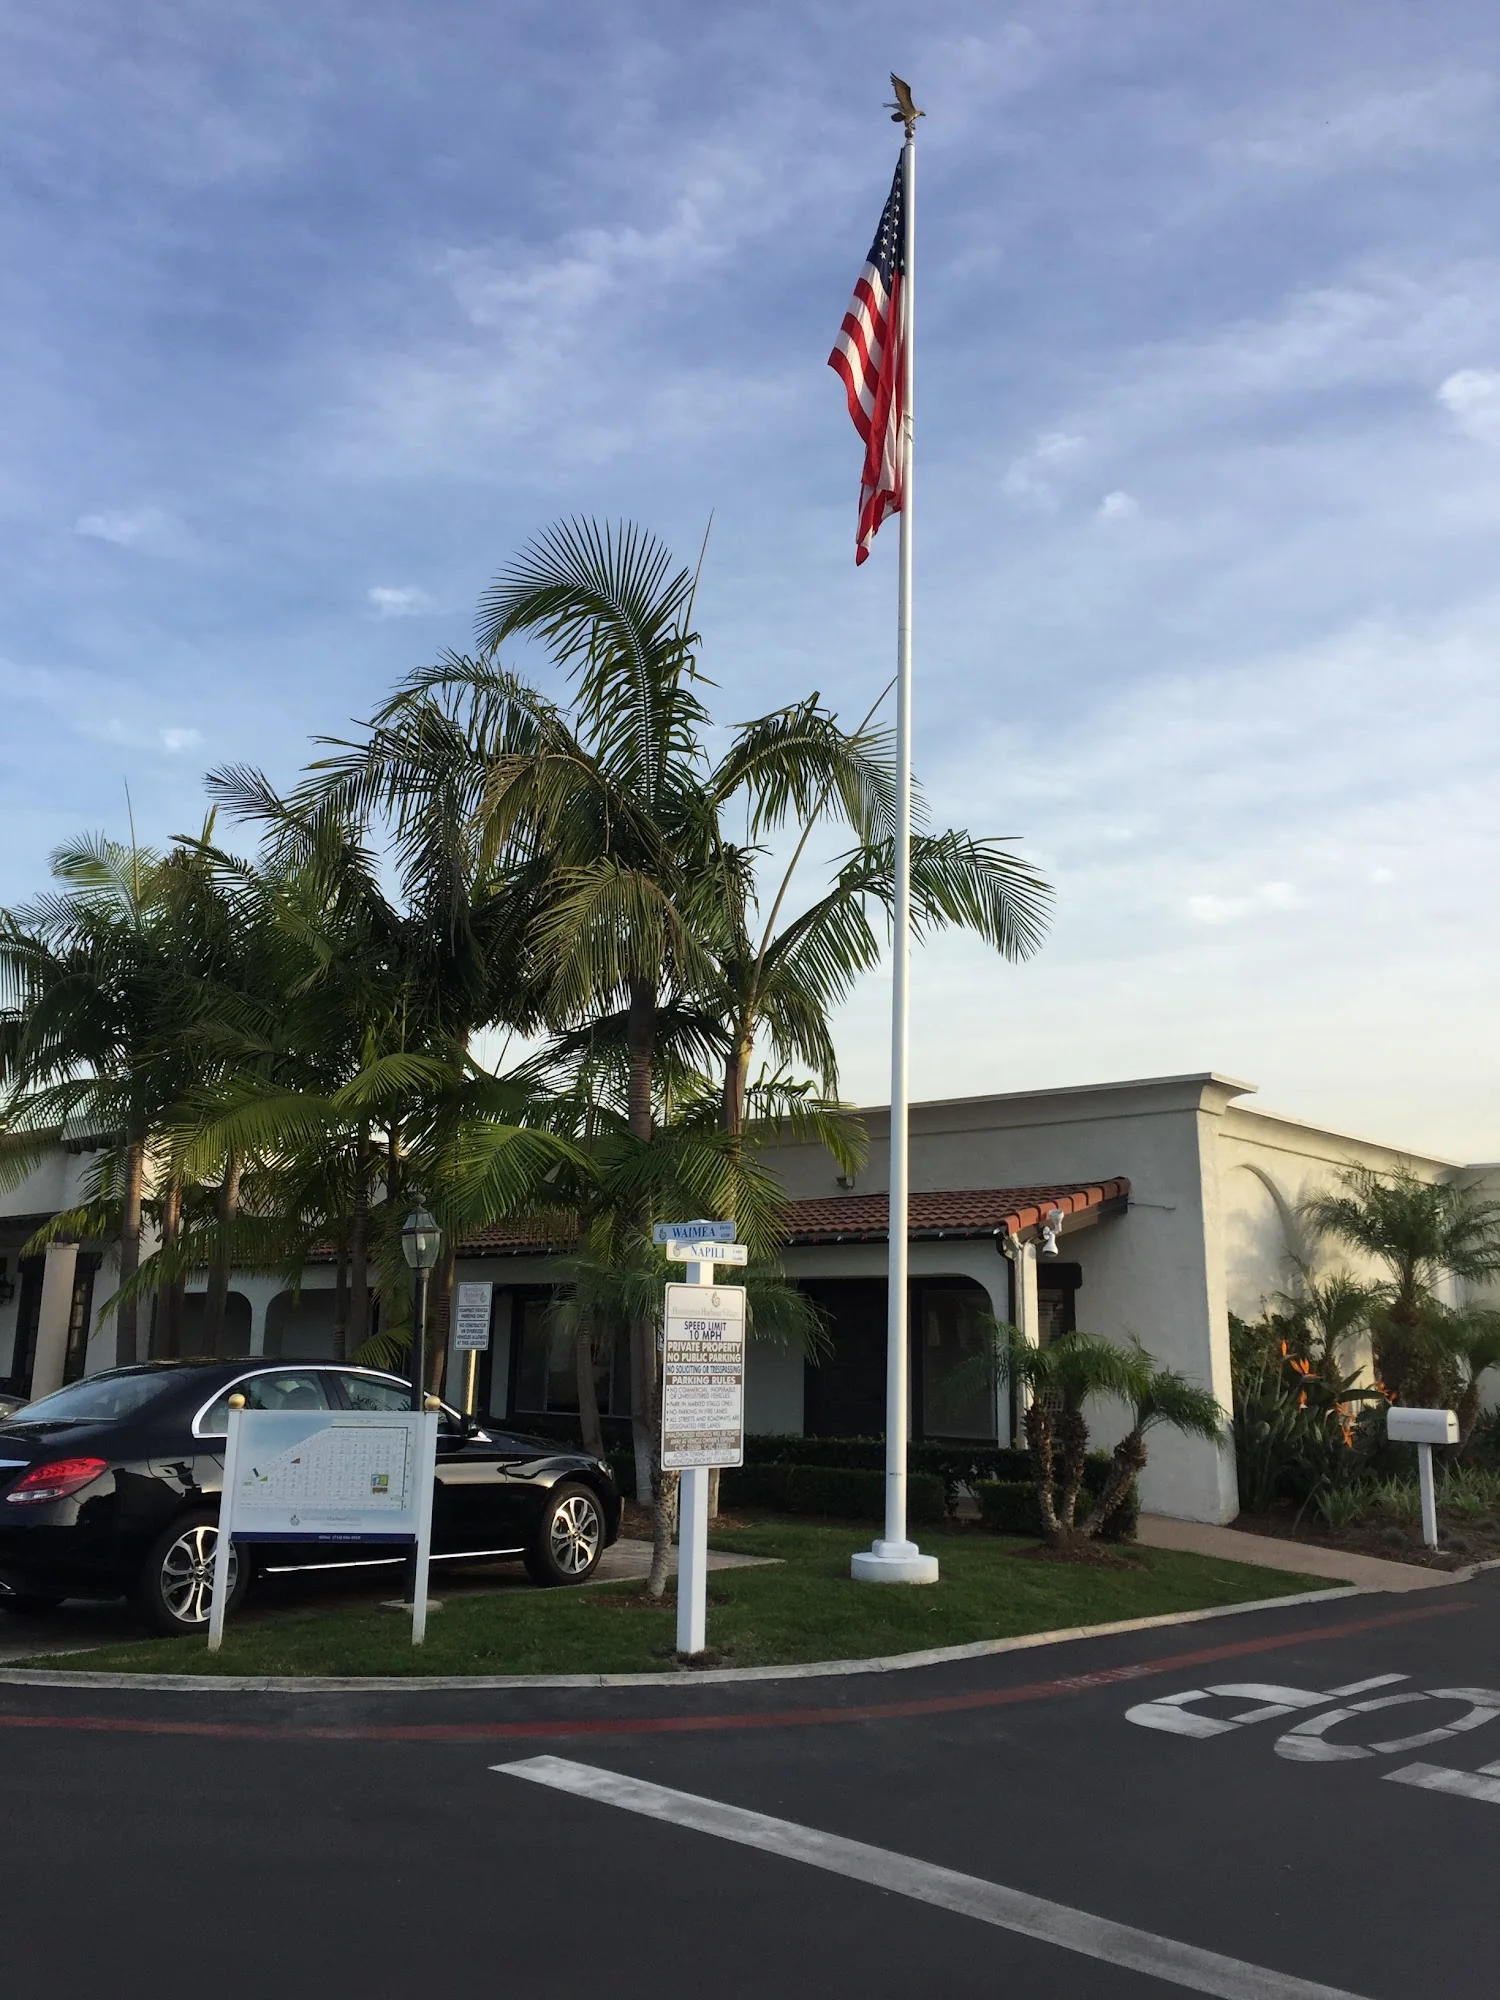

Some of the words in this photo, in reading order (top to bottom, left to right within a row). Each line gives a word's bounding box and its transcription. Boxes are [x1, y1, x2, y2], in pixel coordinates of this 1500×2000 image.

[672, 1225, 715, 1238] WAIMEA
[691, 1245, 725, 1258] NAPILI
[684, 1321, 706, 1330] SPEED
[708, 1322, 727, 1331] LIMIT
[689, 1331, 699, 1340] 10
[702, 1331, 722, 1340] MPH
[667, 1341, 701, 1352] PRIVATE
[702, 1342, 741, 1352] PROPERTY
[667, 1352, 680, 1362] NO
[681, 1353, 708, 1362] PUBLIC
[708, 1353, 741, 1363] PARKING
[667, 1365, 675, 1373] NO
[676, 1365, 702, 1373] SOLICITING
[672, 1376, 709, 1385] PARKING
[711, 1376, 736, 1385] RULES
